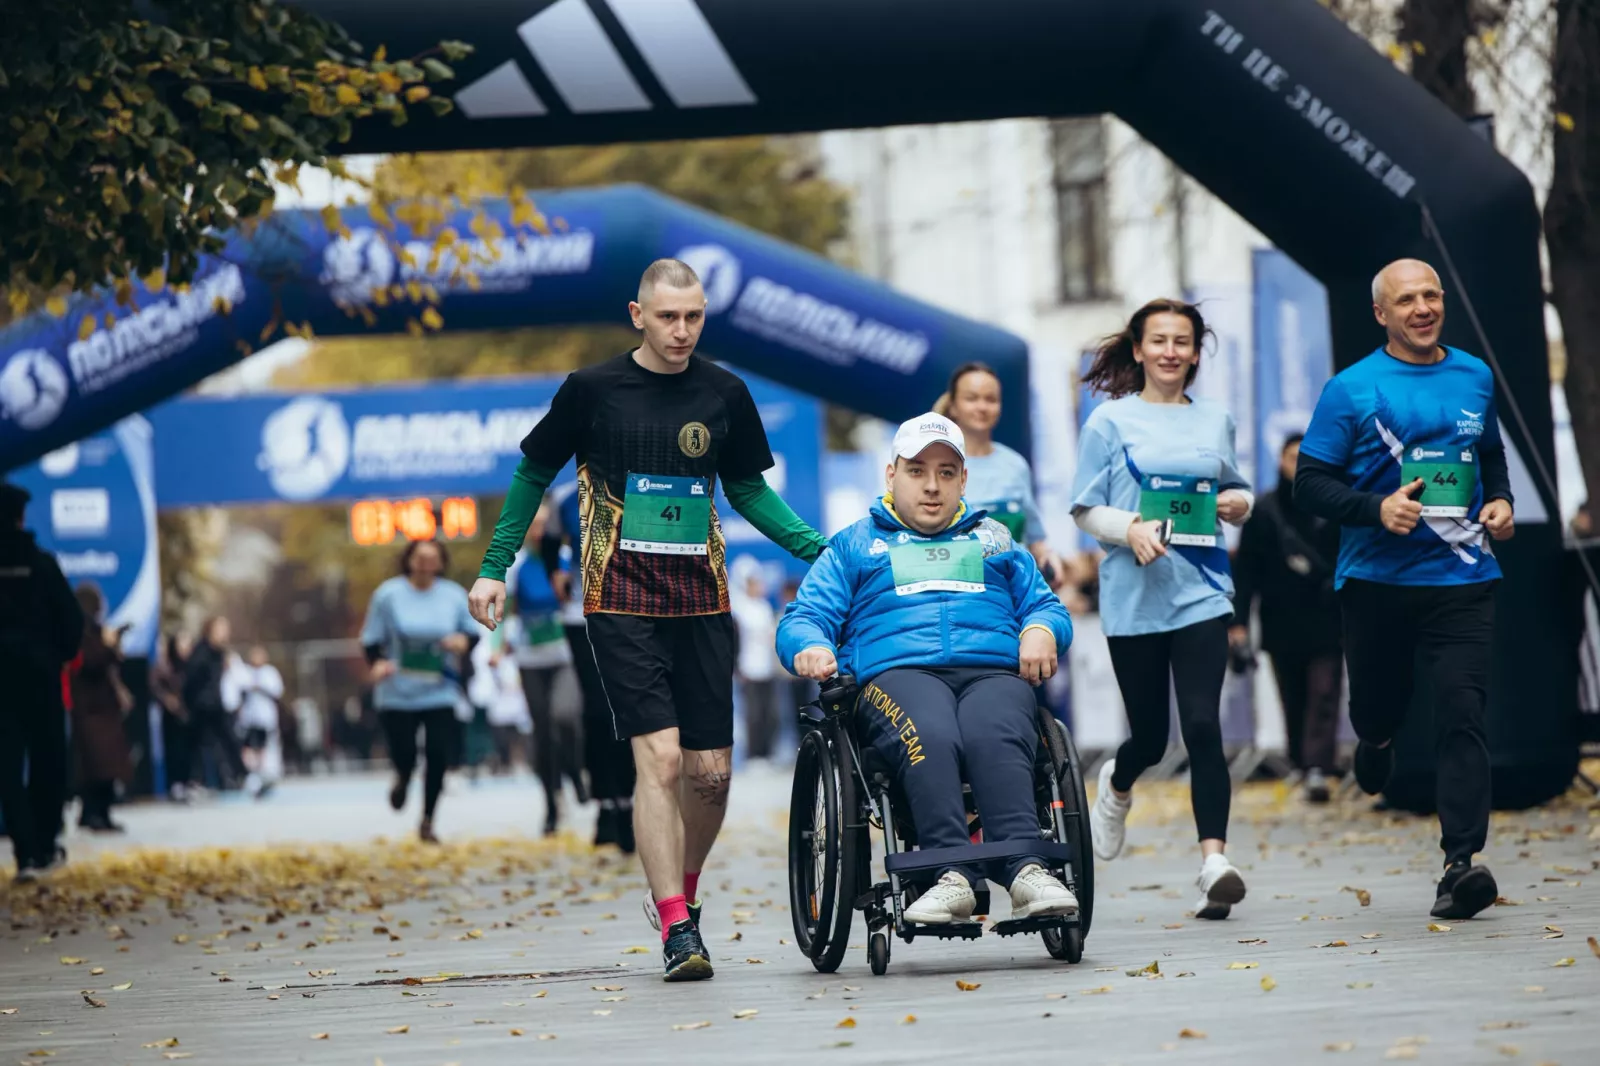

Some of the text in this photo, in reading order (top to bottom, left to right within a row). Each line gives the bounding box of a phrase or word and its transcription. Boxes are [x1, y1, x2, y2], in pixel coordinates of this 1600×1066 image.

[1432, 471, 1458, 486] 44
[660, 505, 682, 522] 41
[1169, 500, 1192, 515] 50
[925, 547, 951, 562] 39
[898, 717, 926, 766] TEAM
